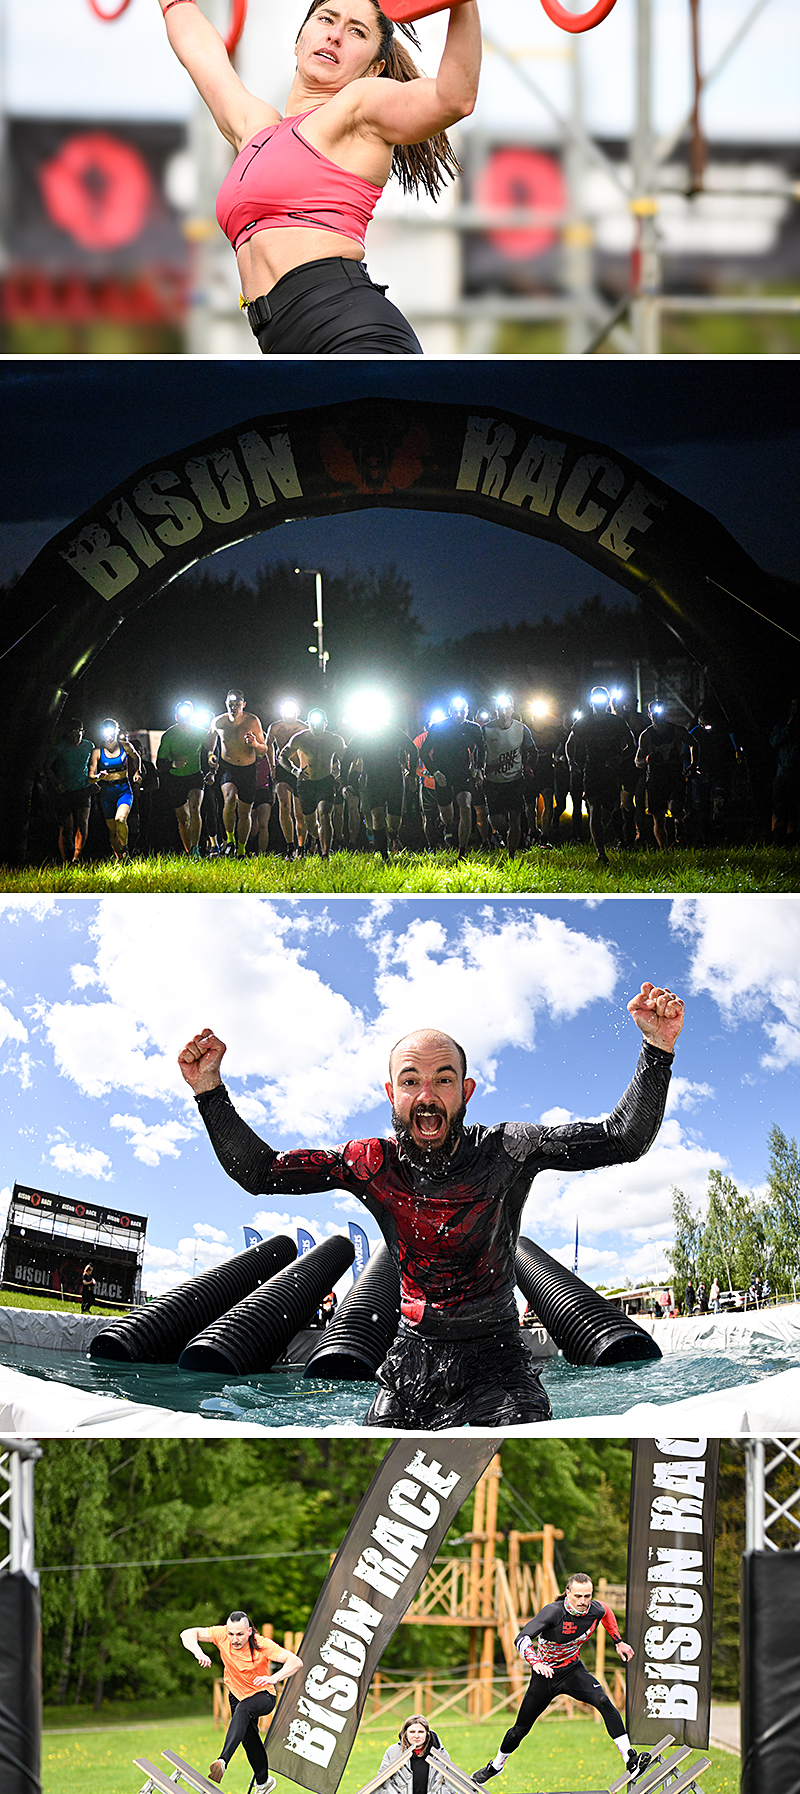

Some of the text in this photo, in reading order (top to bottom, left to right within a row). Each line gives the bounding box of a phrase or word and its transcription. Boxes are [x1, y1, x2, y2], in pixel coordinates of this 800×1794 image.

[57, 415, 667, 601] BISON RACE
[283, 1448, 462, 1769] BISON RACE
[643, 1546, 704, 1721] BISON
